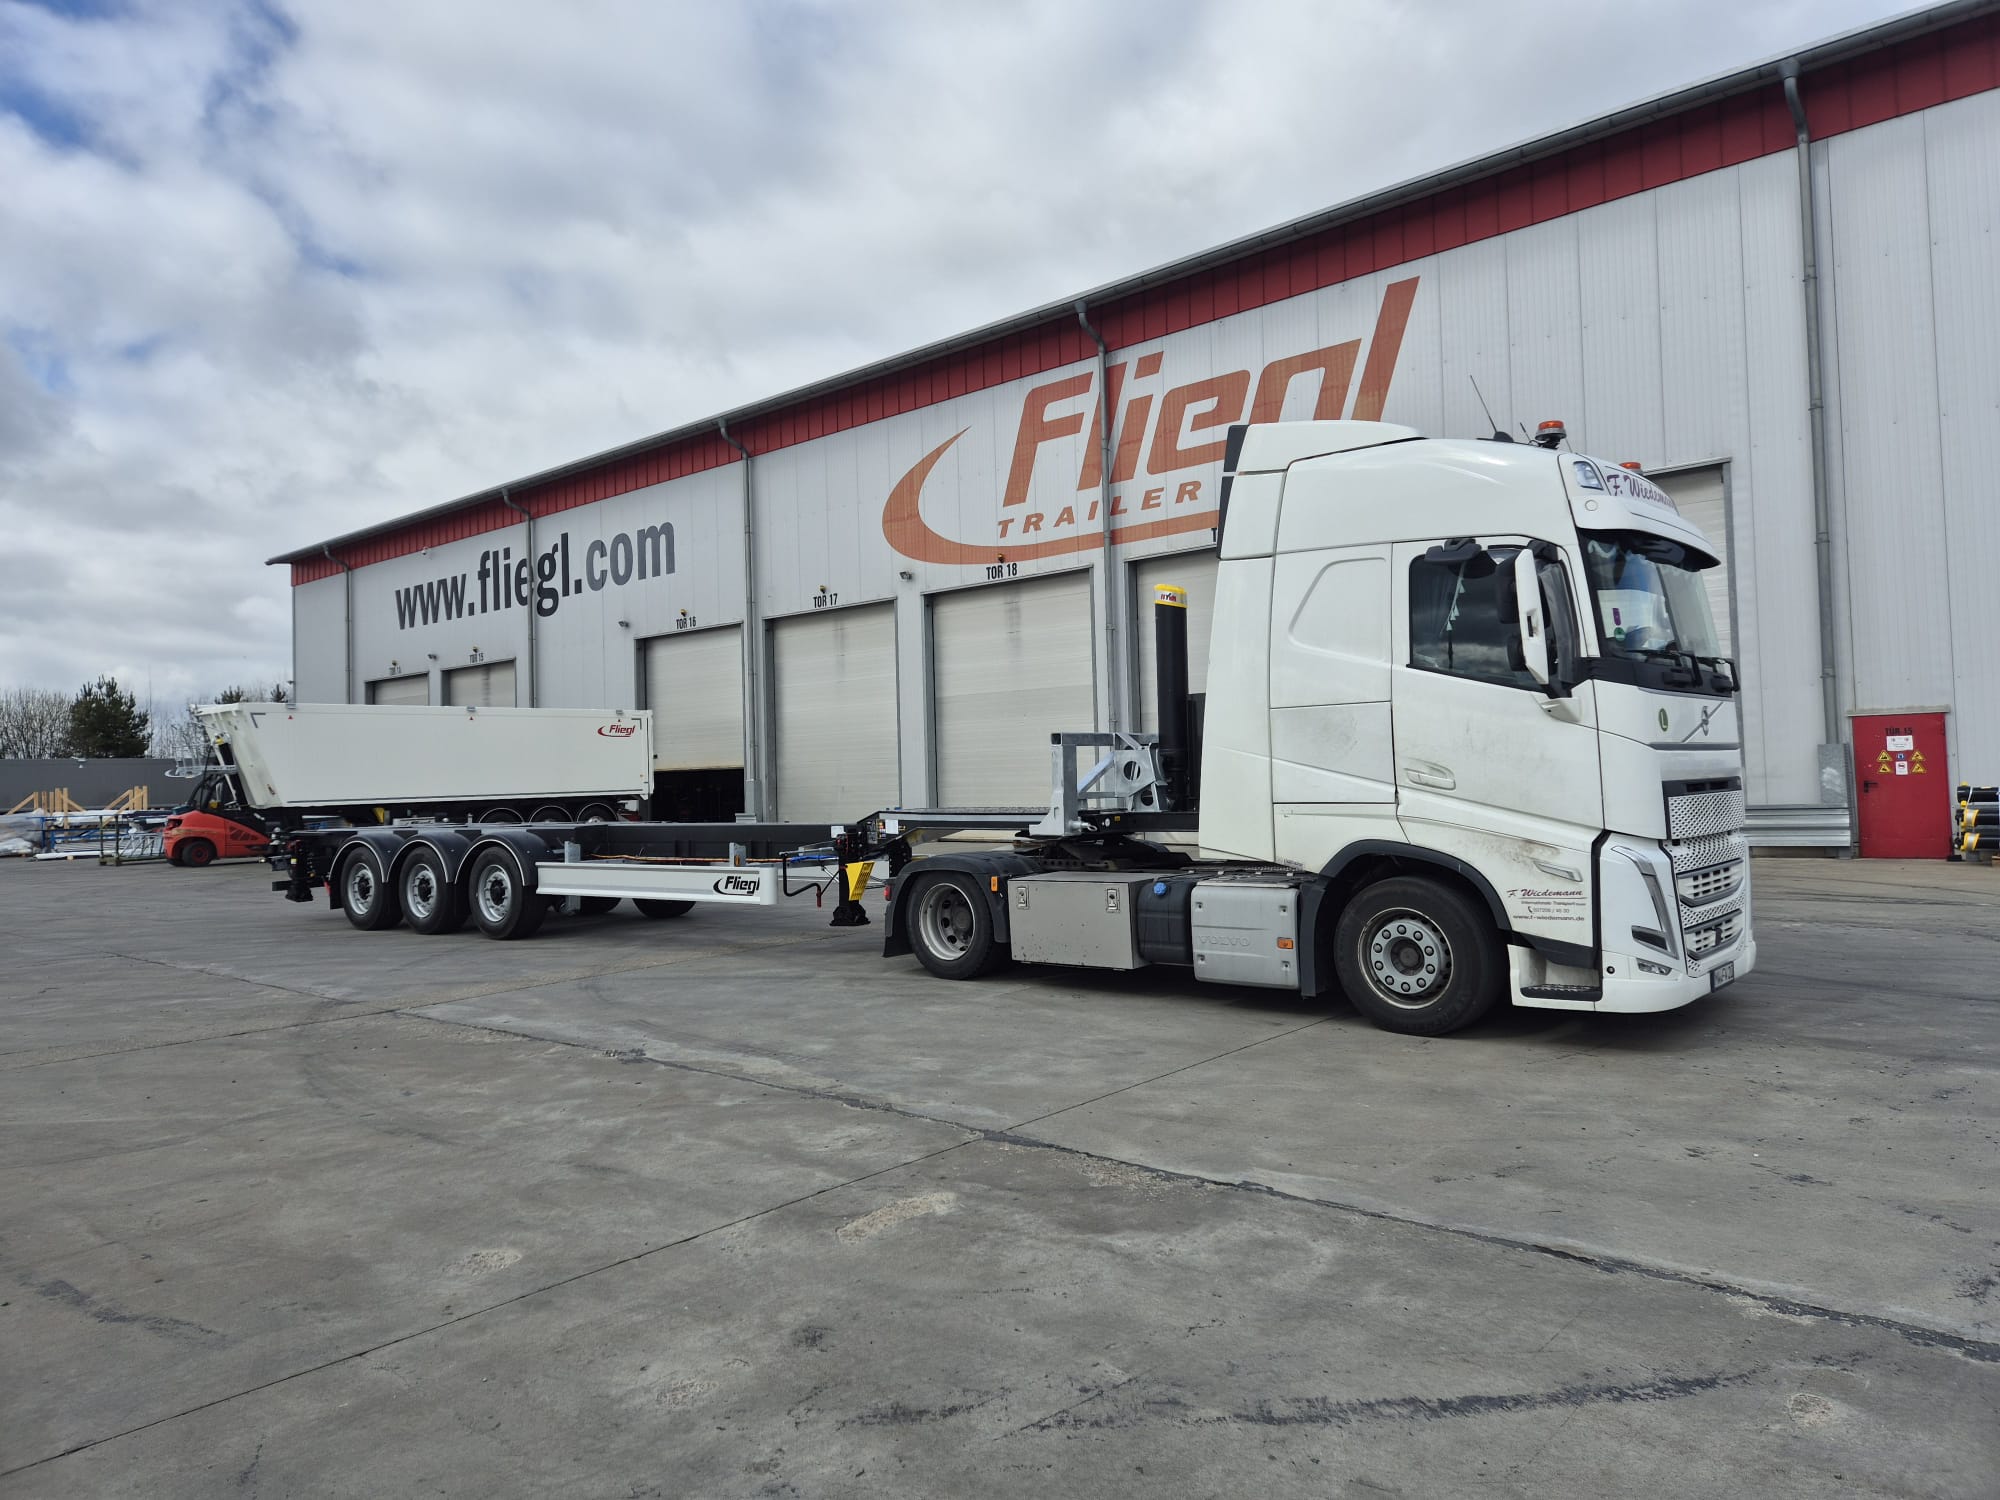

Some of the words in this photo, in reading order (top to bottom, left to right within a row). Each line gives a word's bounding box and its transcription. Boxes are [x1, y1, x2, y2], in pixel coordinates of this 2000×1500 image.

[998, 480, 1202, 538] TRAILER
[395, 521, 676, 630] www.fliegl.com
[986, 565, 1003, 580] TOR
[1007, 562, 1017, 577] 18
[813, 595, 827, 608] TOR
[830, 593, 838, 606] 17
[676, 618, 688, 630] TOR
[689, 616, 697, 627] 16
[609, 724, 636, 736] Fliegl
[724, 875, 760, 894] Fliegl
[1521, 888, 1583, 897] Wiedemann
[1195, 935, 1250, 947] VOLVO
